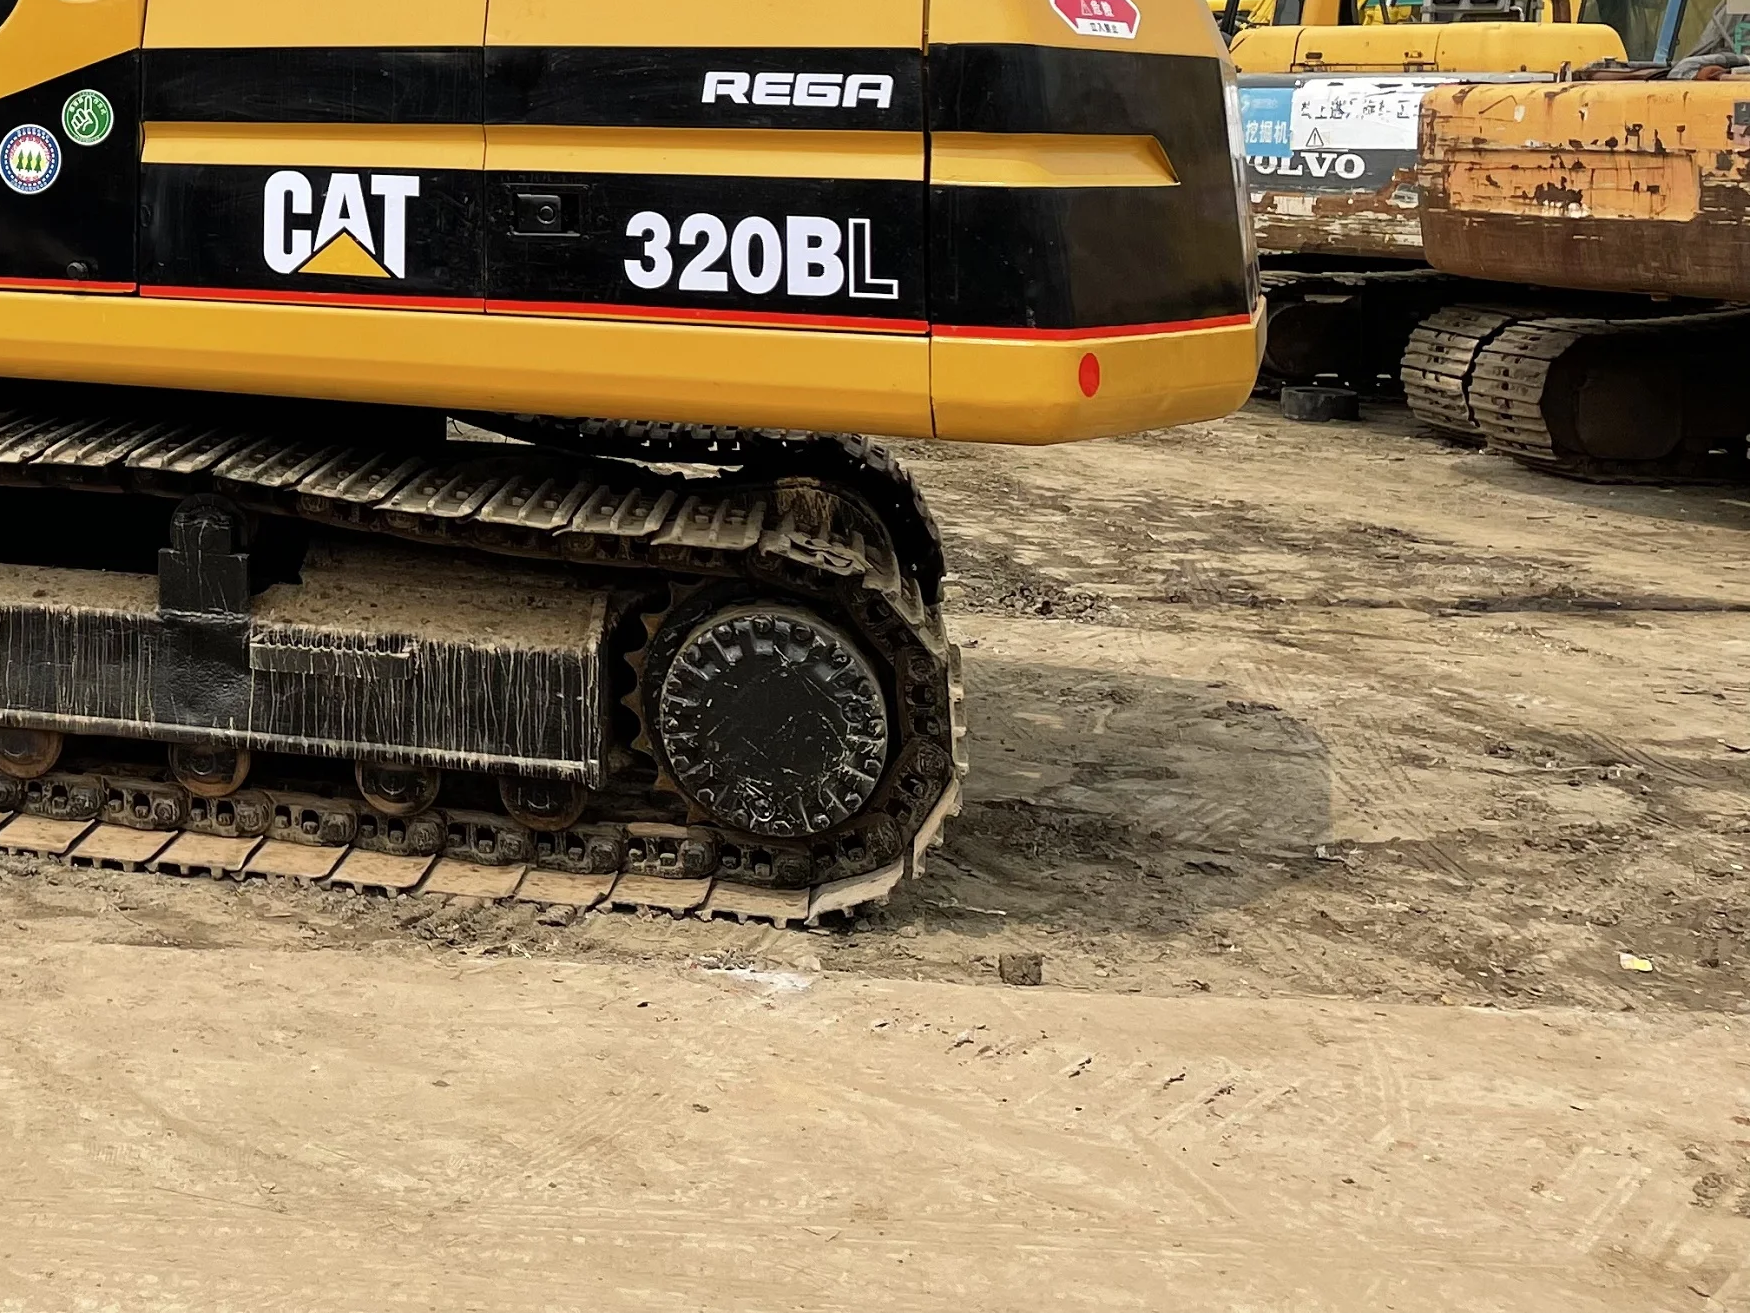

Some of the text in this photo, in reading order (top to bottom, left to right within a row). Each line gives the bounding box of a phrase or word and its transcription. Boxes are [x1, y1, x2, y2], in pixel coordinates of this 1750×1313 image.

[701, 71, 894, 108] REGA
[1245, 119, 1289, 144] 挖掘机
[263, 170, 420, 279] CAT
